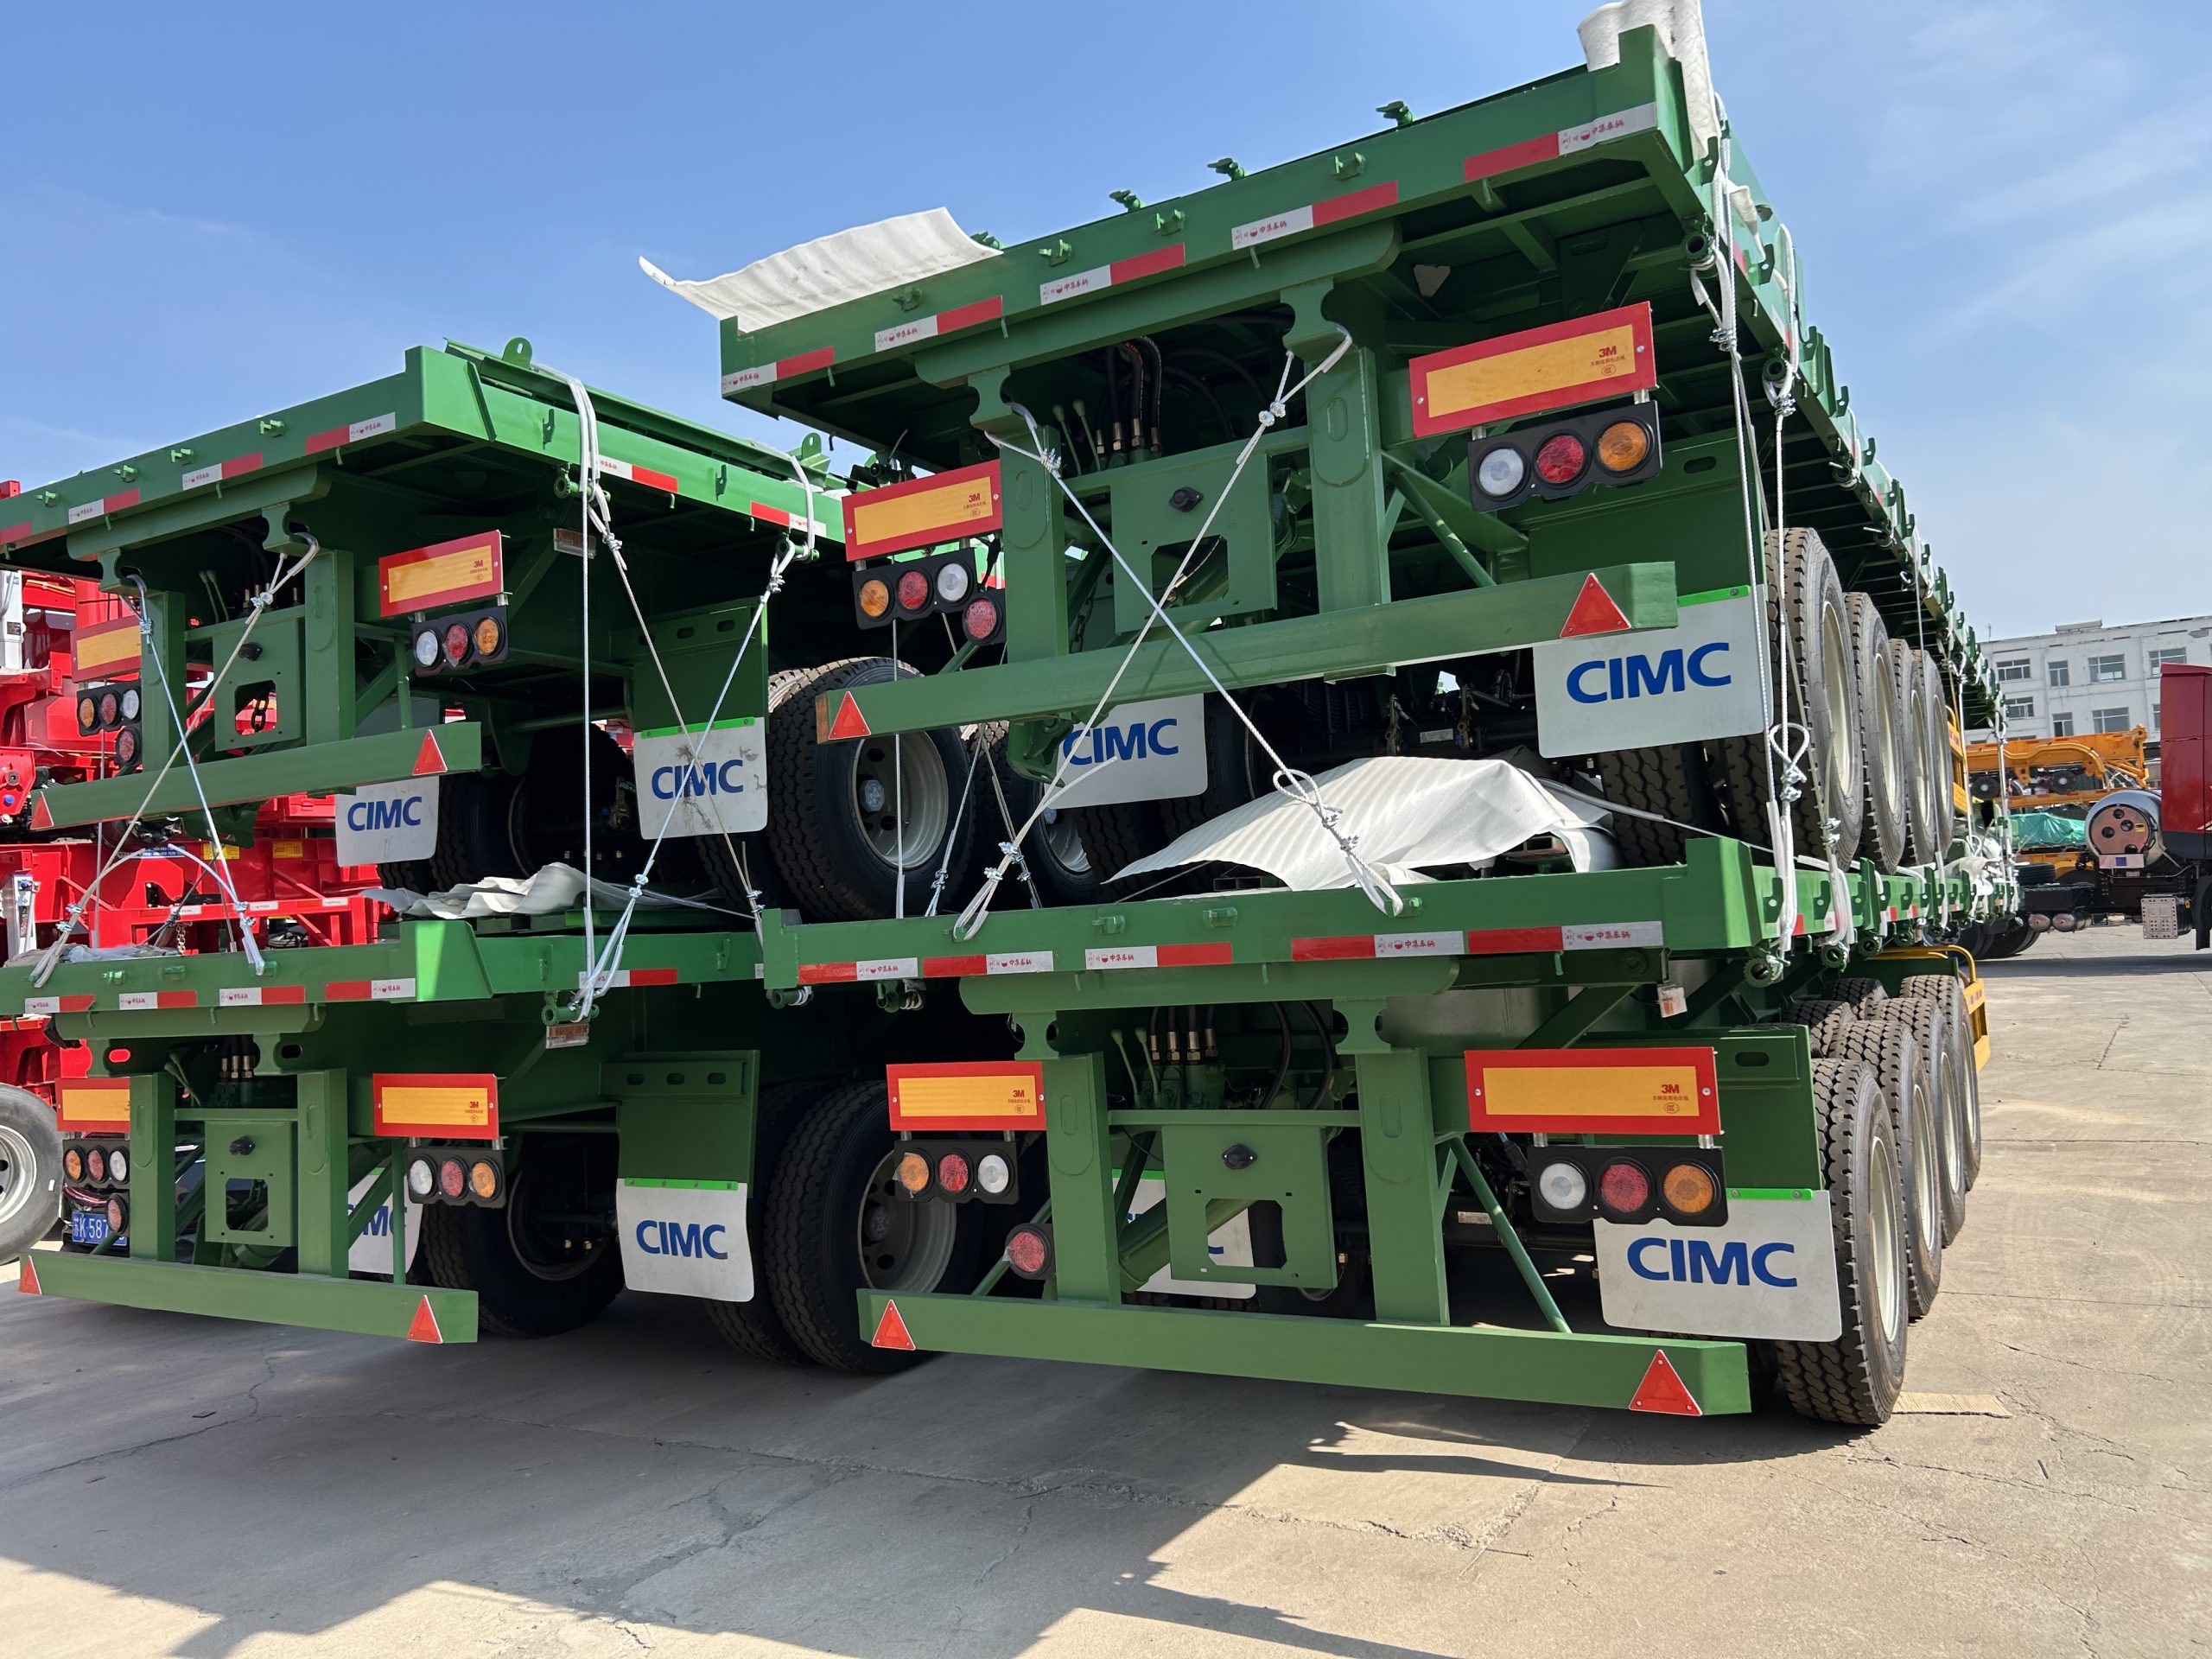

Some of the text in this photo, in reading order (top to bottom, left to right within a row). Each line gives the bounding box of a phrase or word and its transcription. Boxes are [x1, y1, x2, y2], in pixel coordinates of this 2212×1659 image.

[1599, 346, 1617, 358] 3M
[969, 493, 981, 503] 3M
[1567, 642, 1732, 703] CIMC
[1063, 718, 1179, 766] CIMC
[652, 760, 744, 799] CIMC
[347, 796, 422, 831] CIMC
[1661, 1084, 1680, 1094] 3M
[636, 1219, 728, 1260] CIMC
[1627, 1237, 1797, 1287] CIMC
